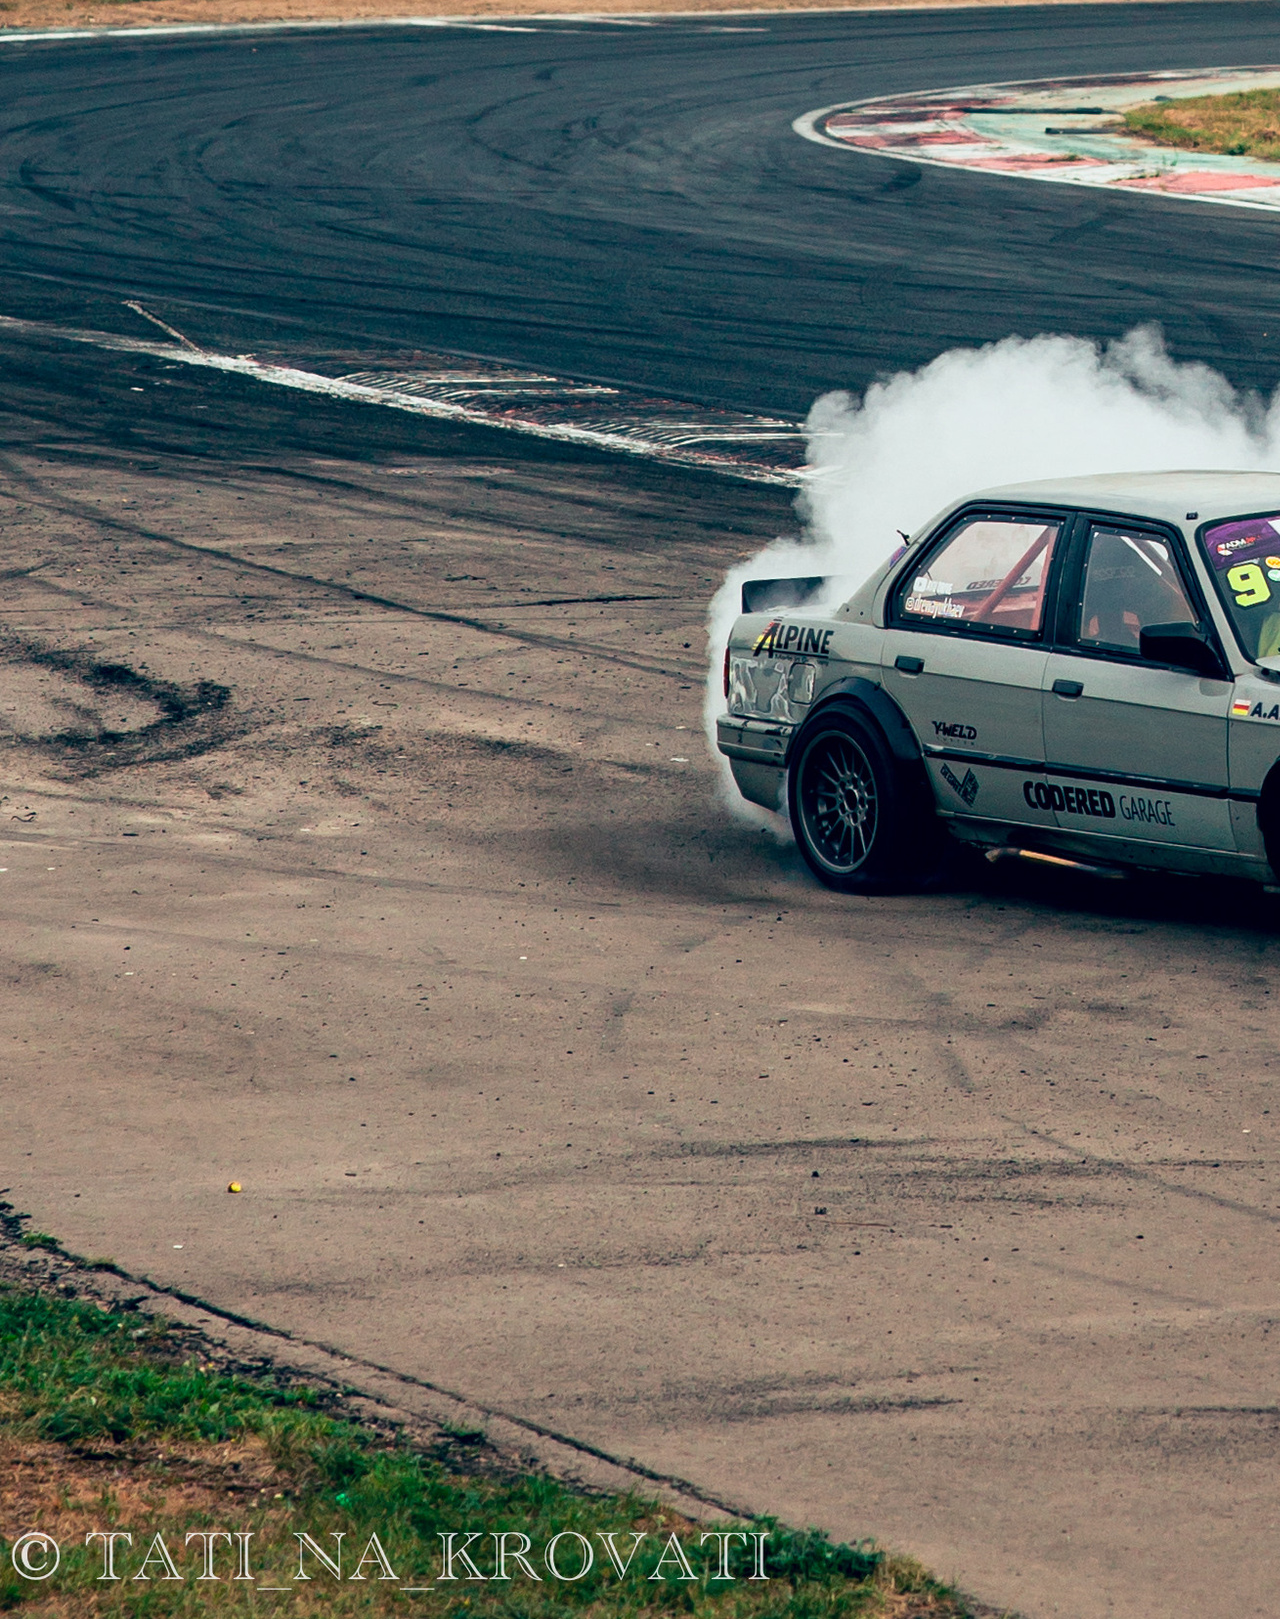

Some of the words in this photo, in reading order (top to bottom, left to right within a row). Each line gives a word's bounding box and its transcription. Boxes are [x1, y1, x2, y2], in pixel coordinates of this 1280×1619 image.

[1227, 563, 1271, 607] 9
[753, 622, 834, 659] ALPINE
[1023, 780, 1116, 819] CODERED
[1119, 795, 1176, 827] GARAGE
